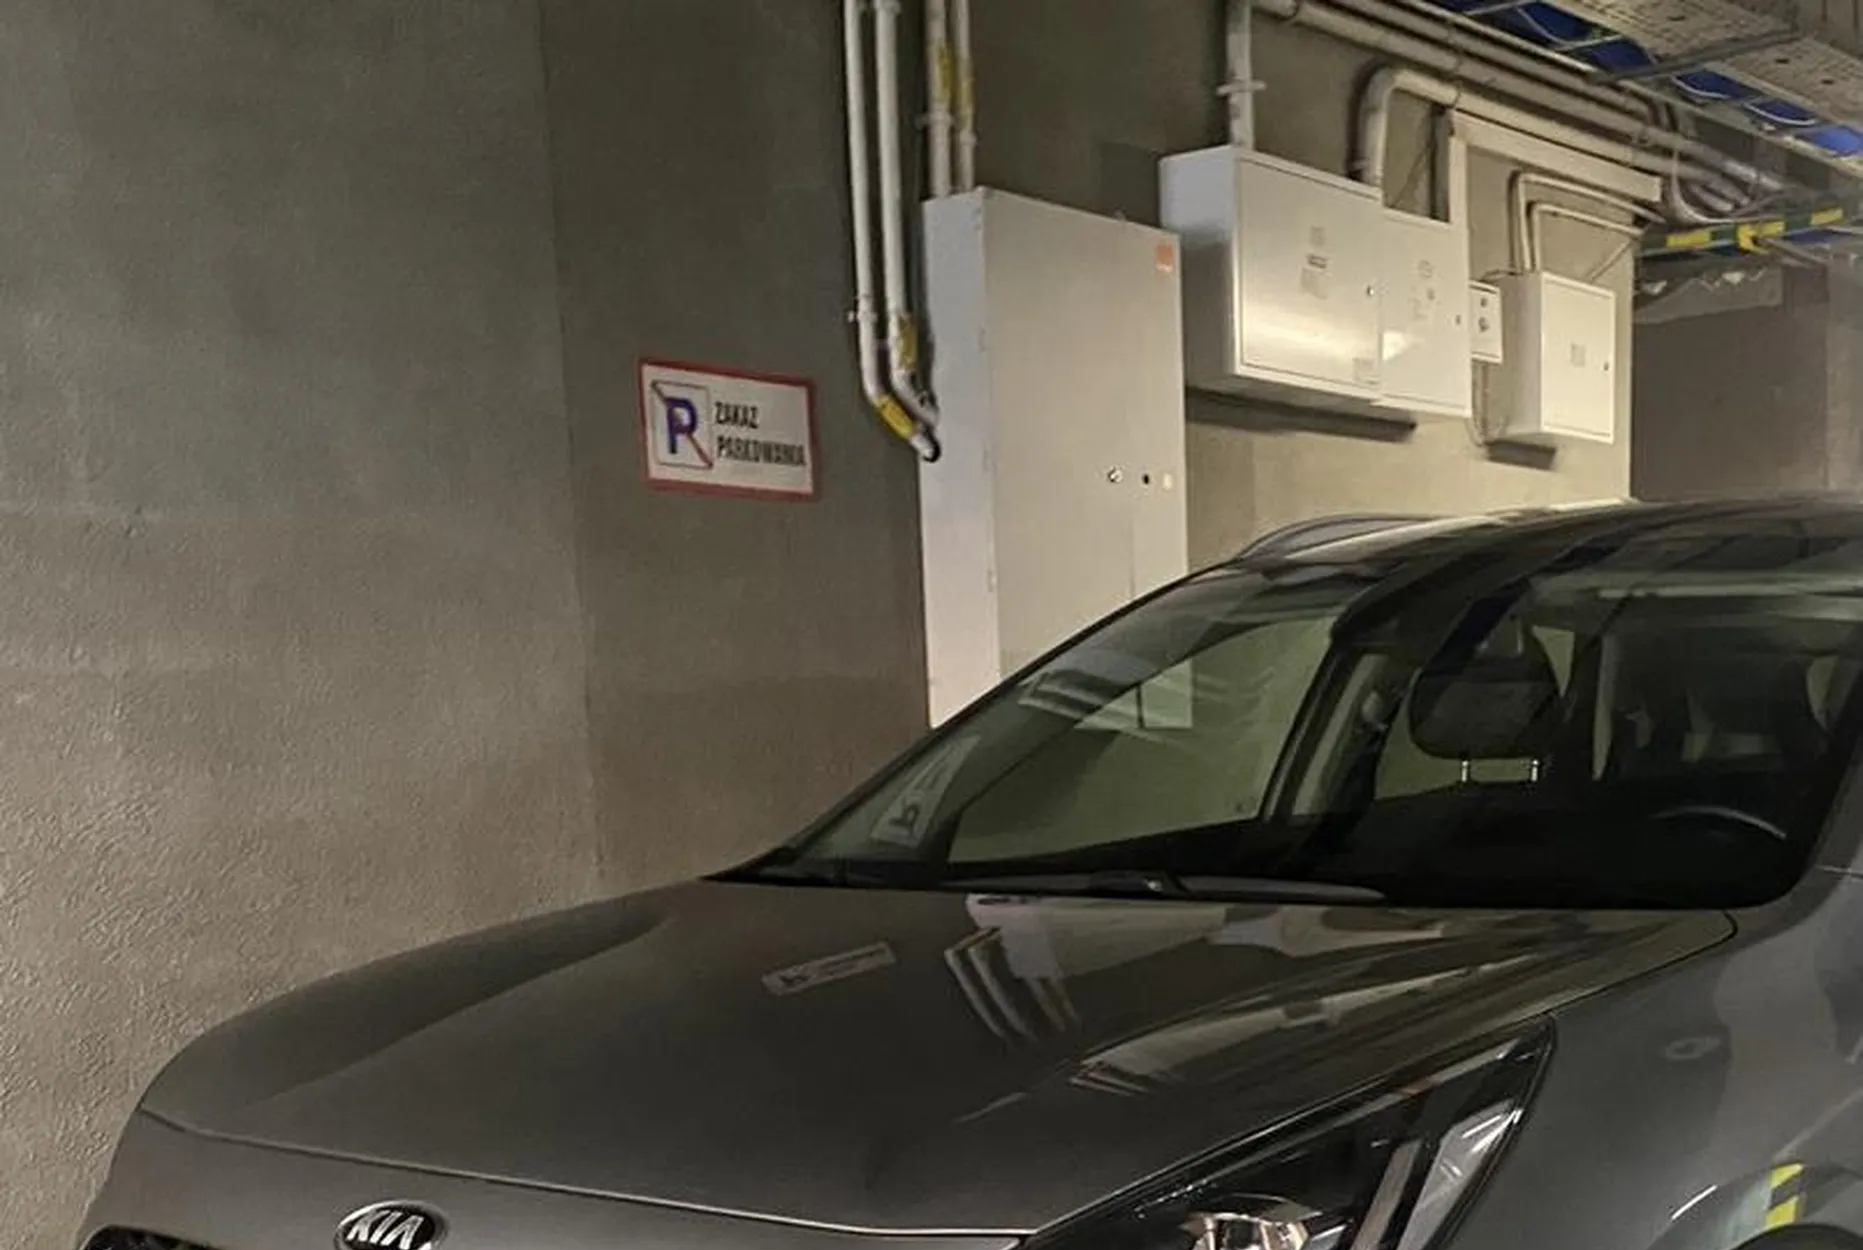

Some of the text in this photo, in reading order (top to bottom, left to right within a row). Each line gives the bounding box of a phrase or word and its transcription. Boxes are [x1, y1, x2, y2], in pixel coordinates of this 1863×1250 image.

[714, 401, 759, 430] ZAKAZ
[716, 435, 807, 467] PARKOWANIA
[346, 1209, 424, 1250] KIA
